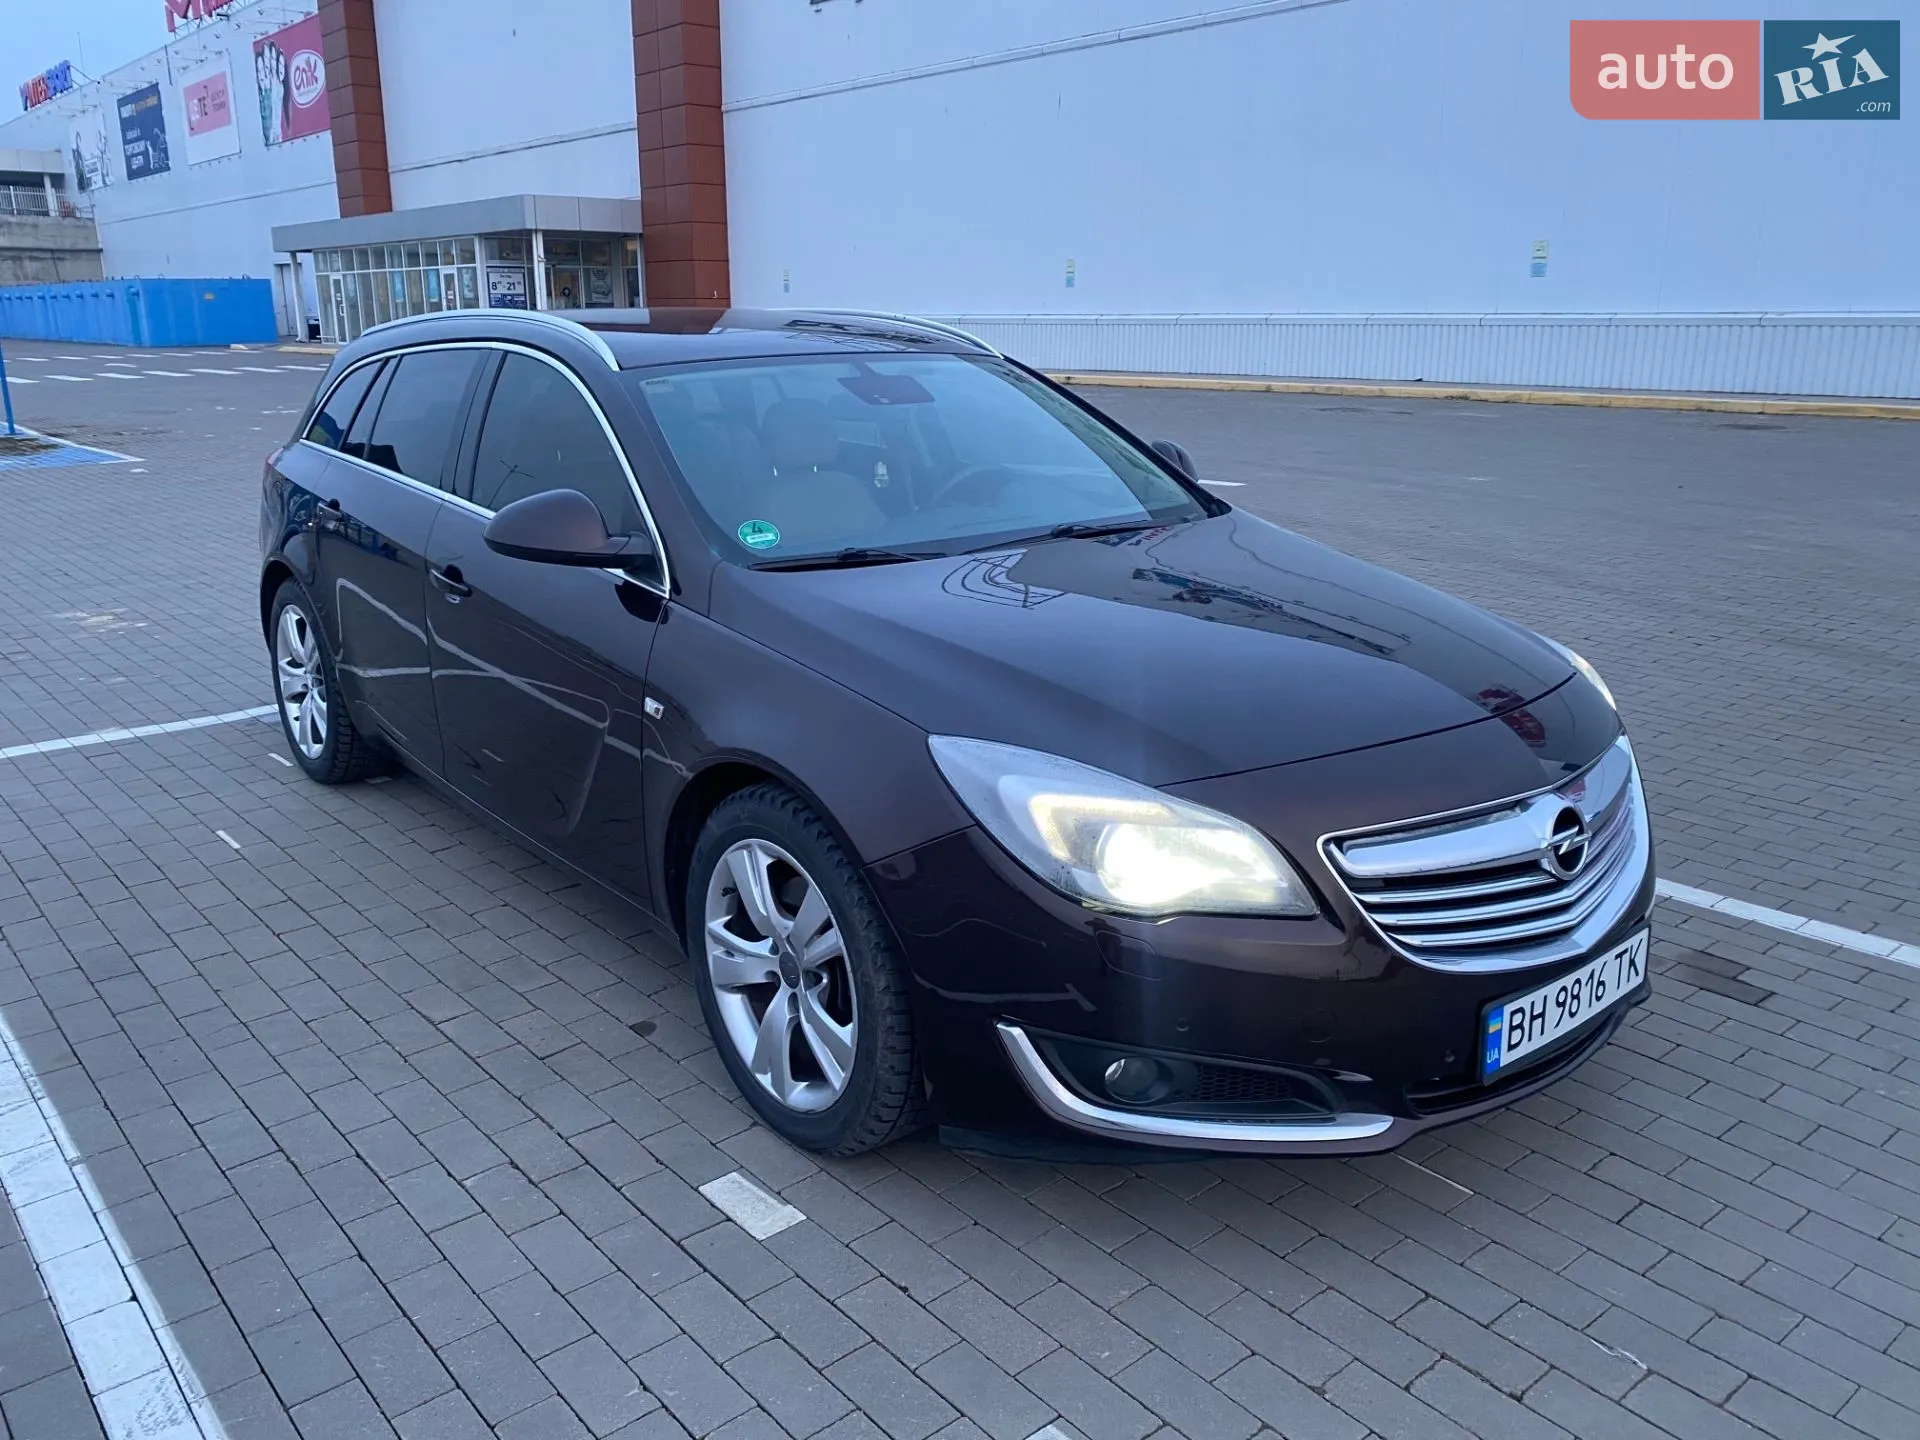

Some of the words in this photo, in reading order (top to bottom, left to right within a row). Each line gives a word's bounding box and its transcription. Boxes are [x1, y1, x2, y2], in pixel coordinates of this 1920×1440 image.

[1507, 993, 1548, 1053] BH
[1553, 960, 1609, 1030] 9816
[1614, 937, 1644, 991] TK
[1486, 1048, 1500, 1065] UA
